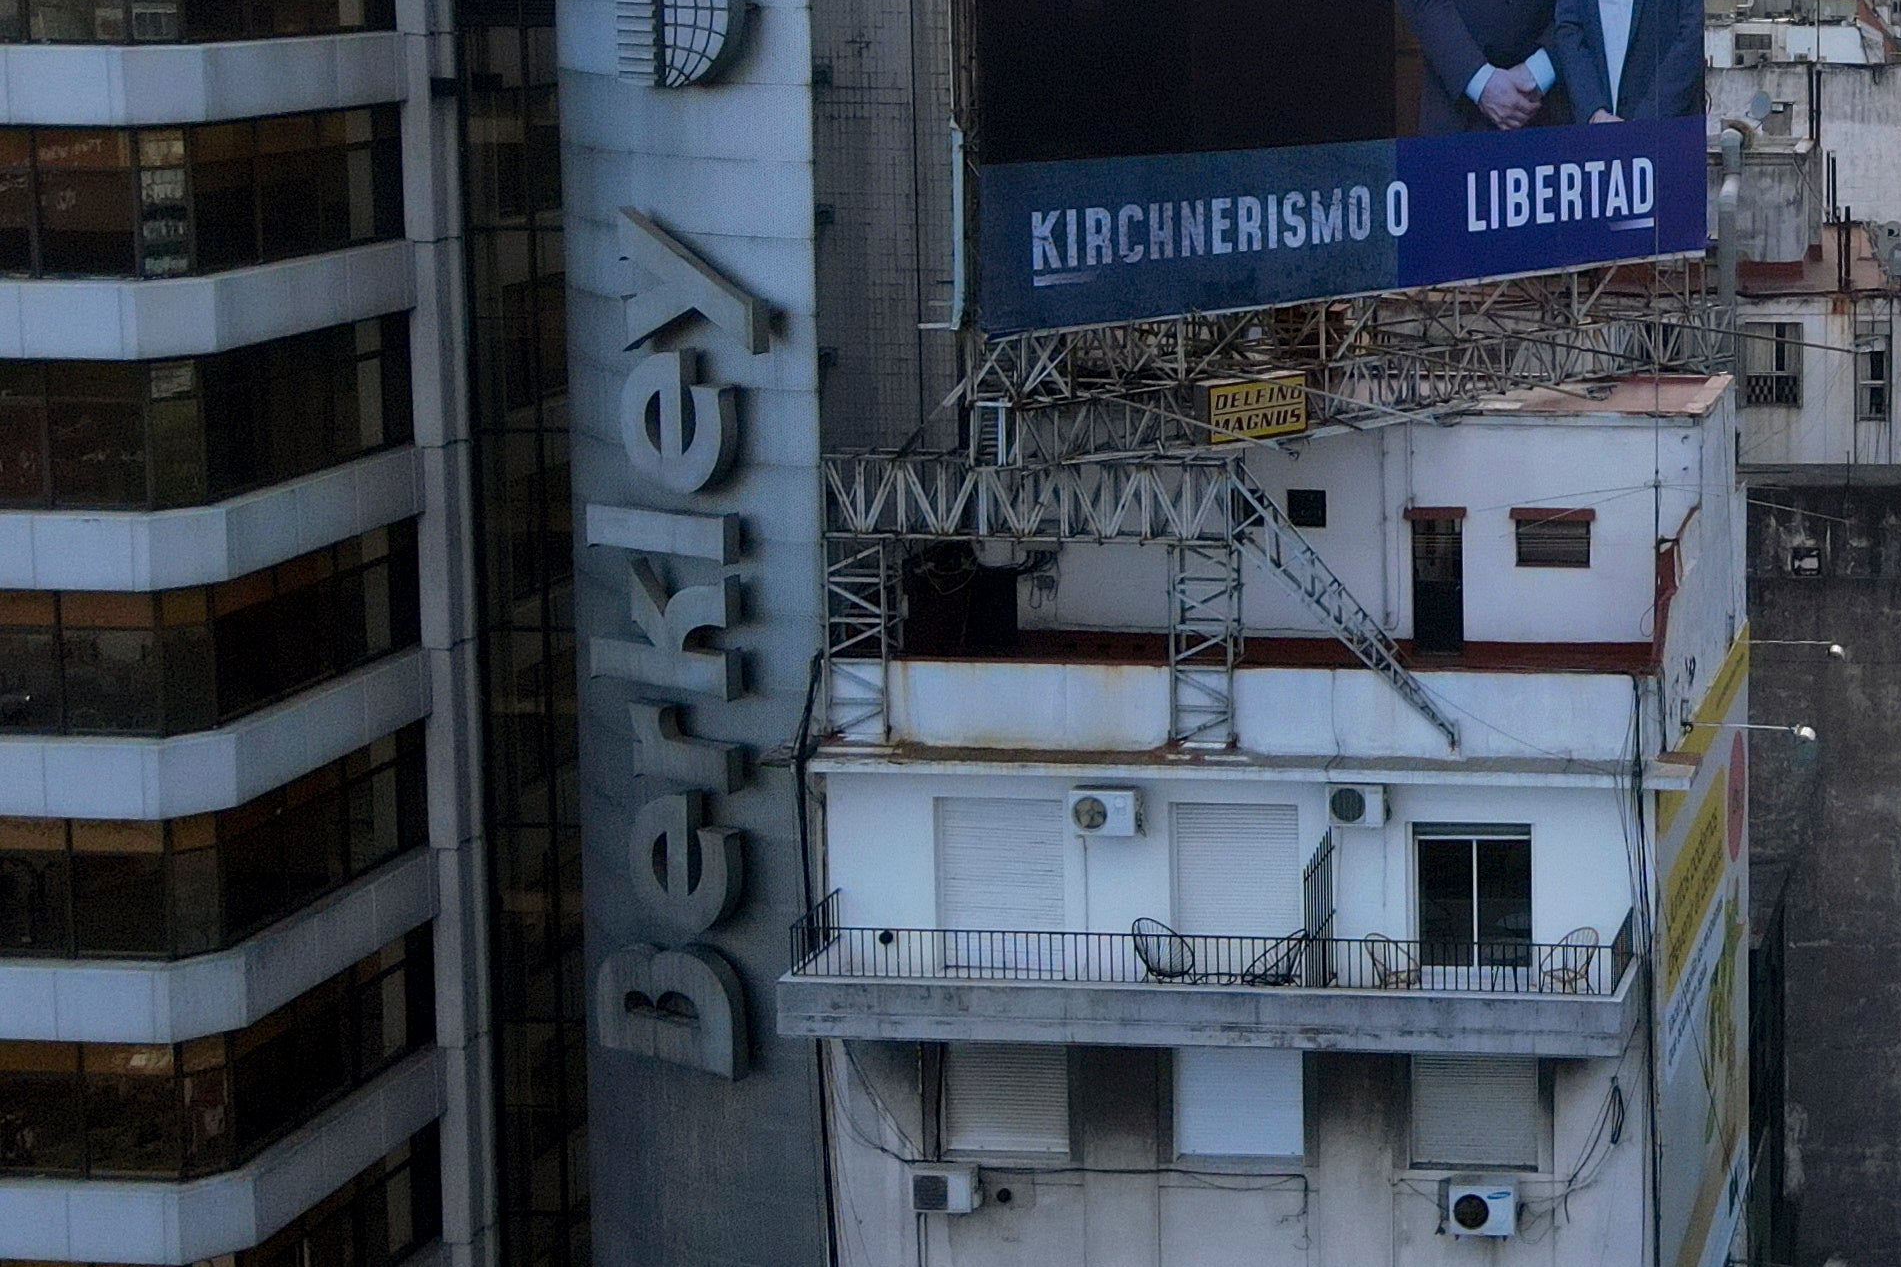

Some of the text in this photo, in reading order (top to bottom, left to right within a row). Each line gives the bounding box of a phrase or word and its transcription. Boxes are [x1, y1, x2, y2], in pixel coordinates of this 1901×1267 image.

[1031, 156, 1655, 272] KIRCHNERISMO O LIBERTAD
[1213, 407, 1302, 436] MAGNUS
[1214, 383, 1304, 411] DELFINO
[587, 205, 772, 1081] Berkley
